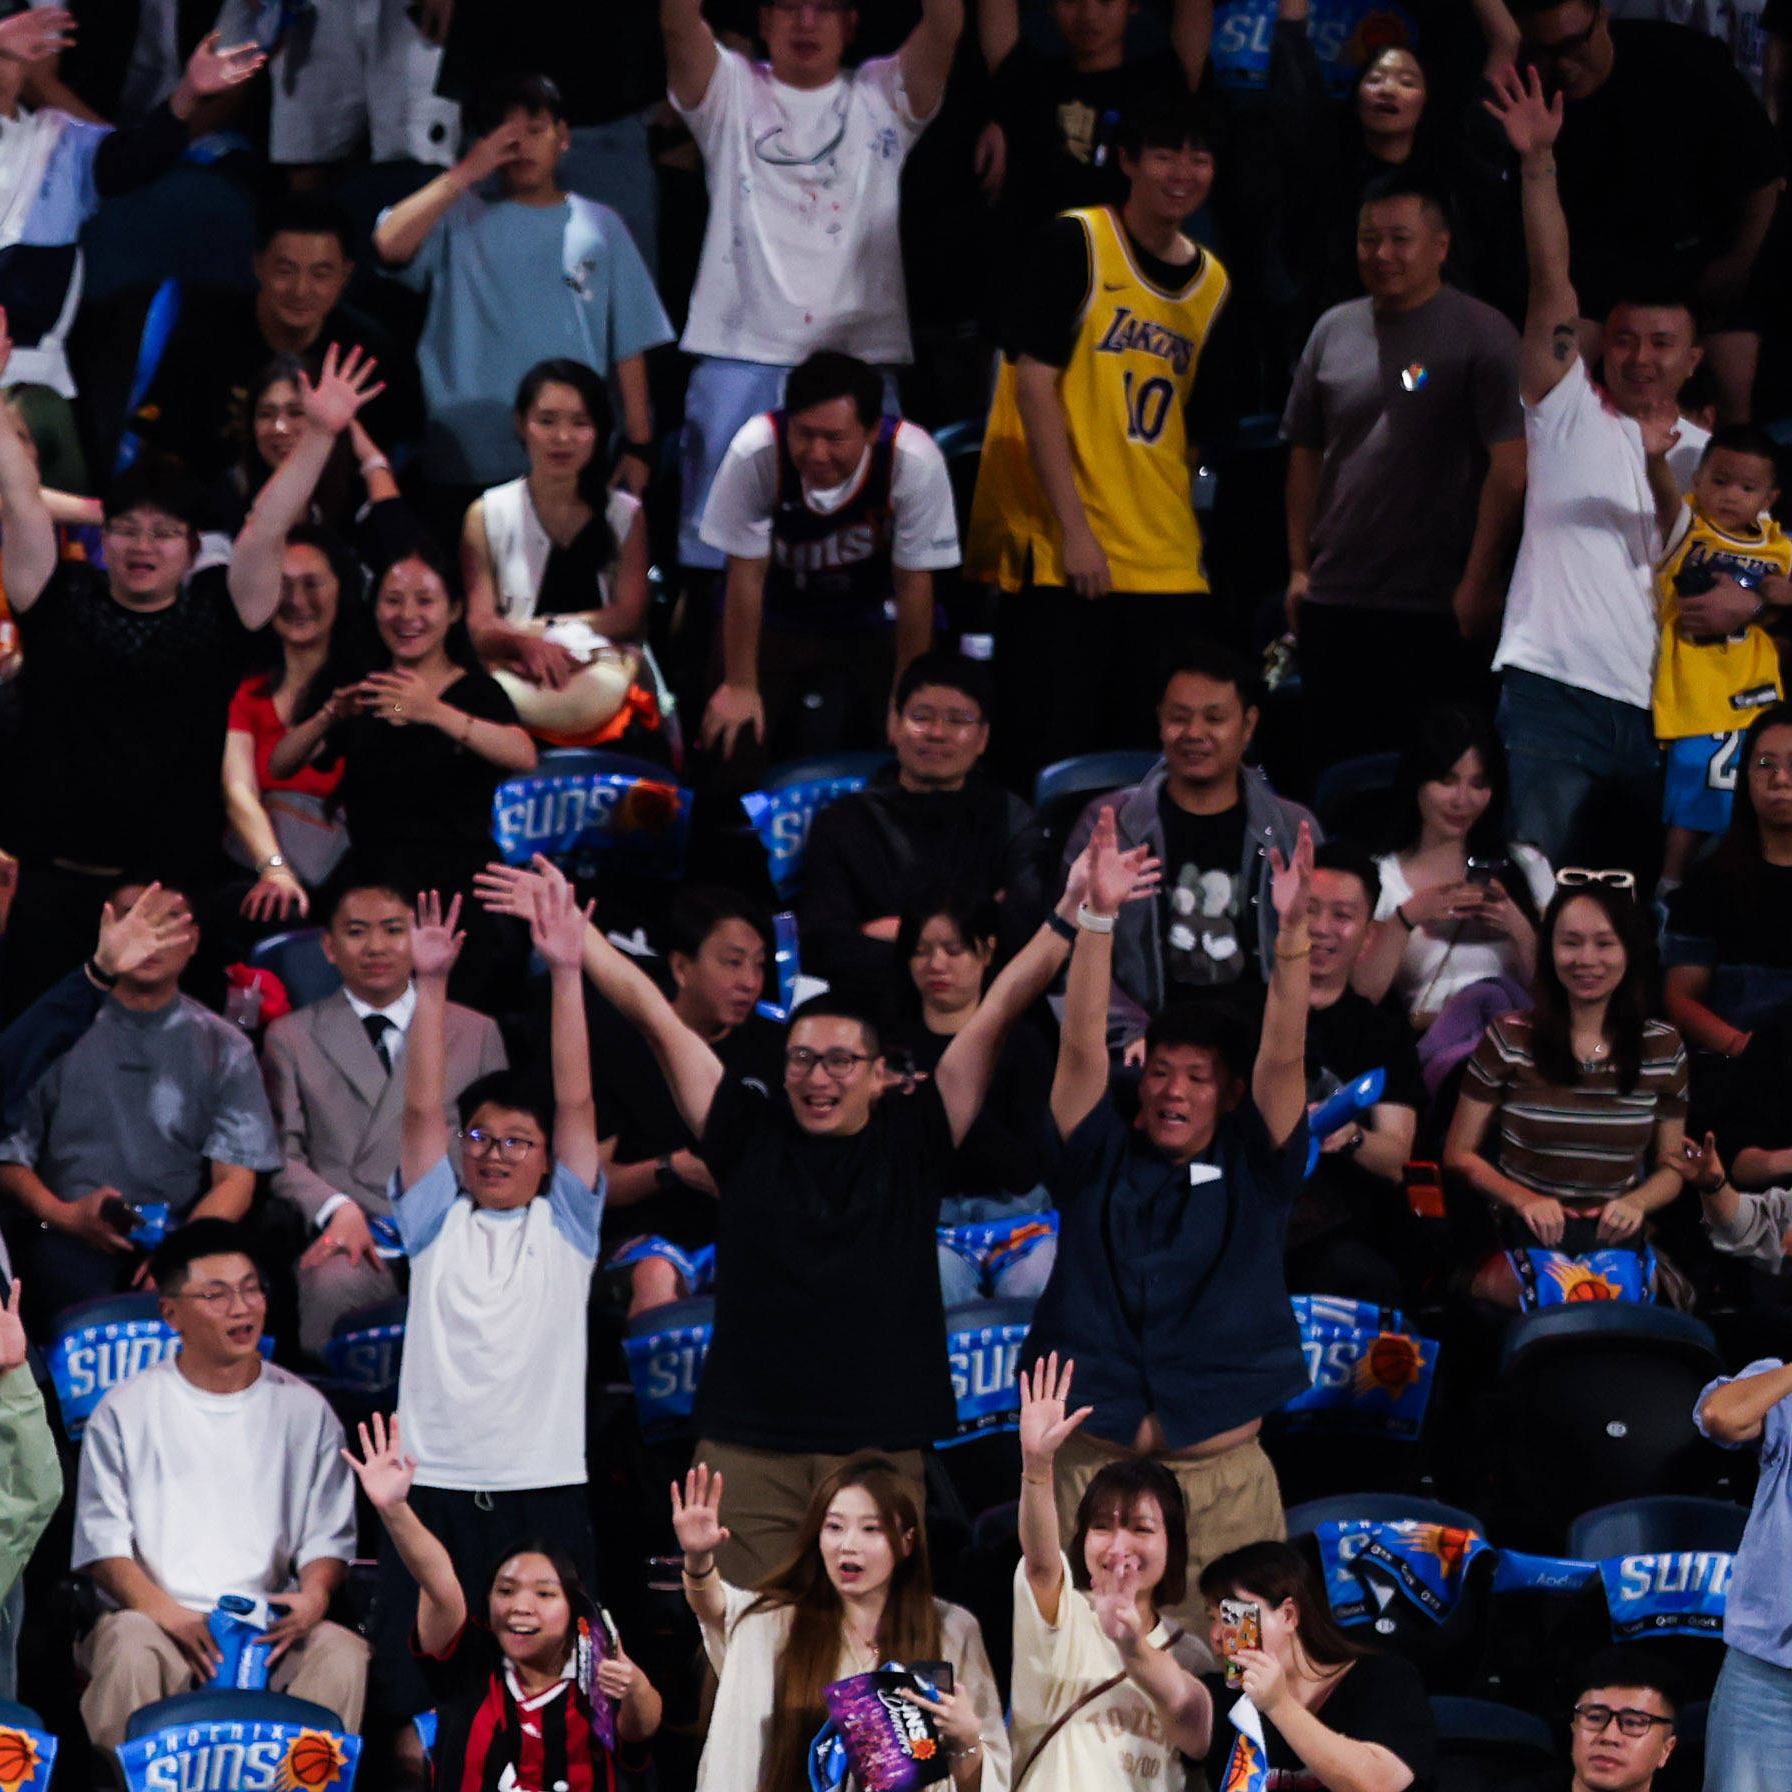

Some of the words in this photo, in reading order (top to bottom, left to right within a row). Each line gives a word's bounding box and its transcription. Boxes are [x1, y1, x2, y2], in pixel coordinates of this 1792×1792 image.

[1123, 370, 1174, 443] 10
[69, 1336, 185, 1398] SUN
[143, 1723, 285, 1760] PHOENIX
